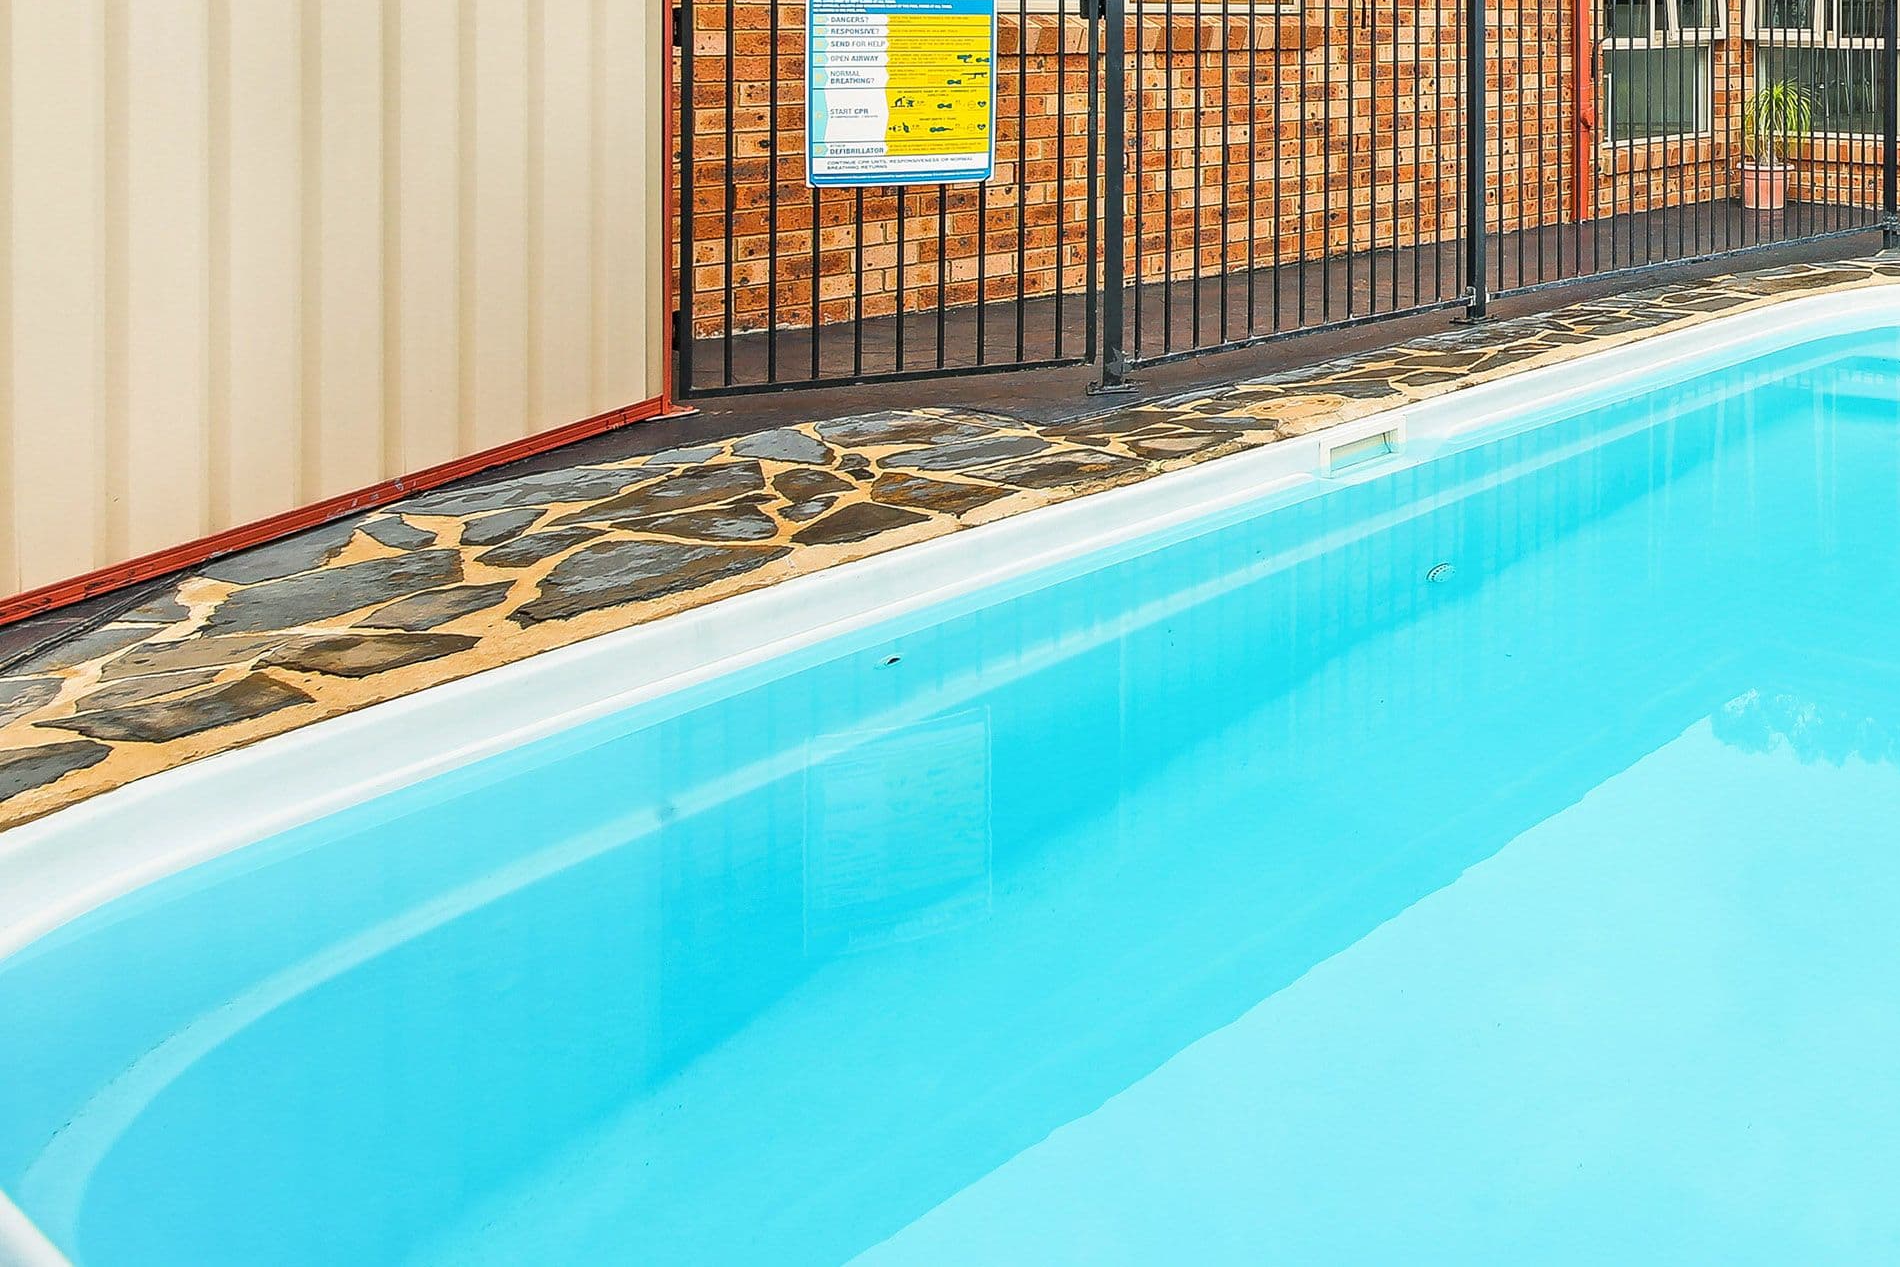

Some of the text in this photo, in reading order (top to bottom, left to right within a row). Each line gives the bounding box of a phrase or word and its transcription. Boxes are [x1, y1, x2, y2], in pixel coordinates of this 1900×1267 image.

[831, 27, 880, 35] RESPONSIVE?
[831, 40, 850, 48] SEND
[852, 40, 866, 48] FOR
[867, 40, 886, 48] HELP
[830, 77, 875, 85] BREATHING?
[830, 147, 884, 155] DEFIBRILLATOR
